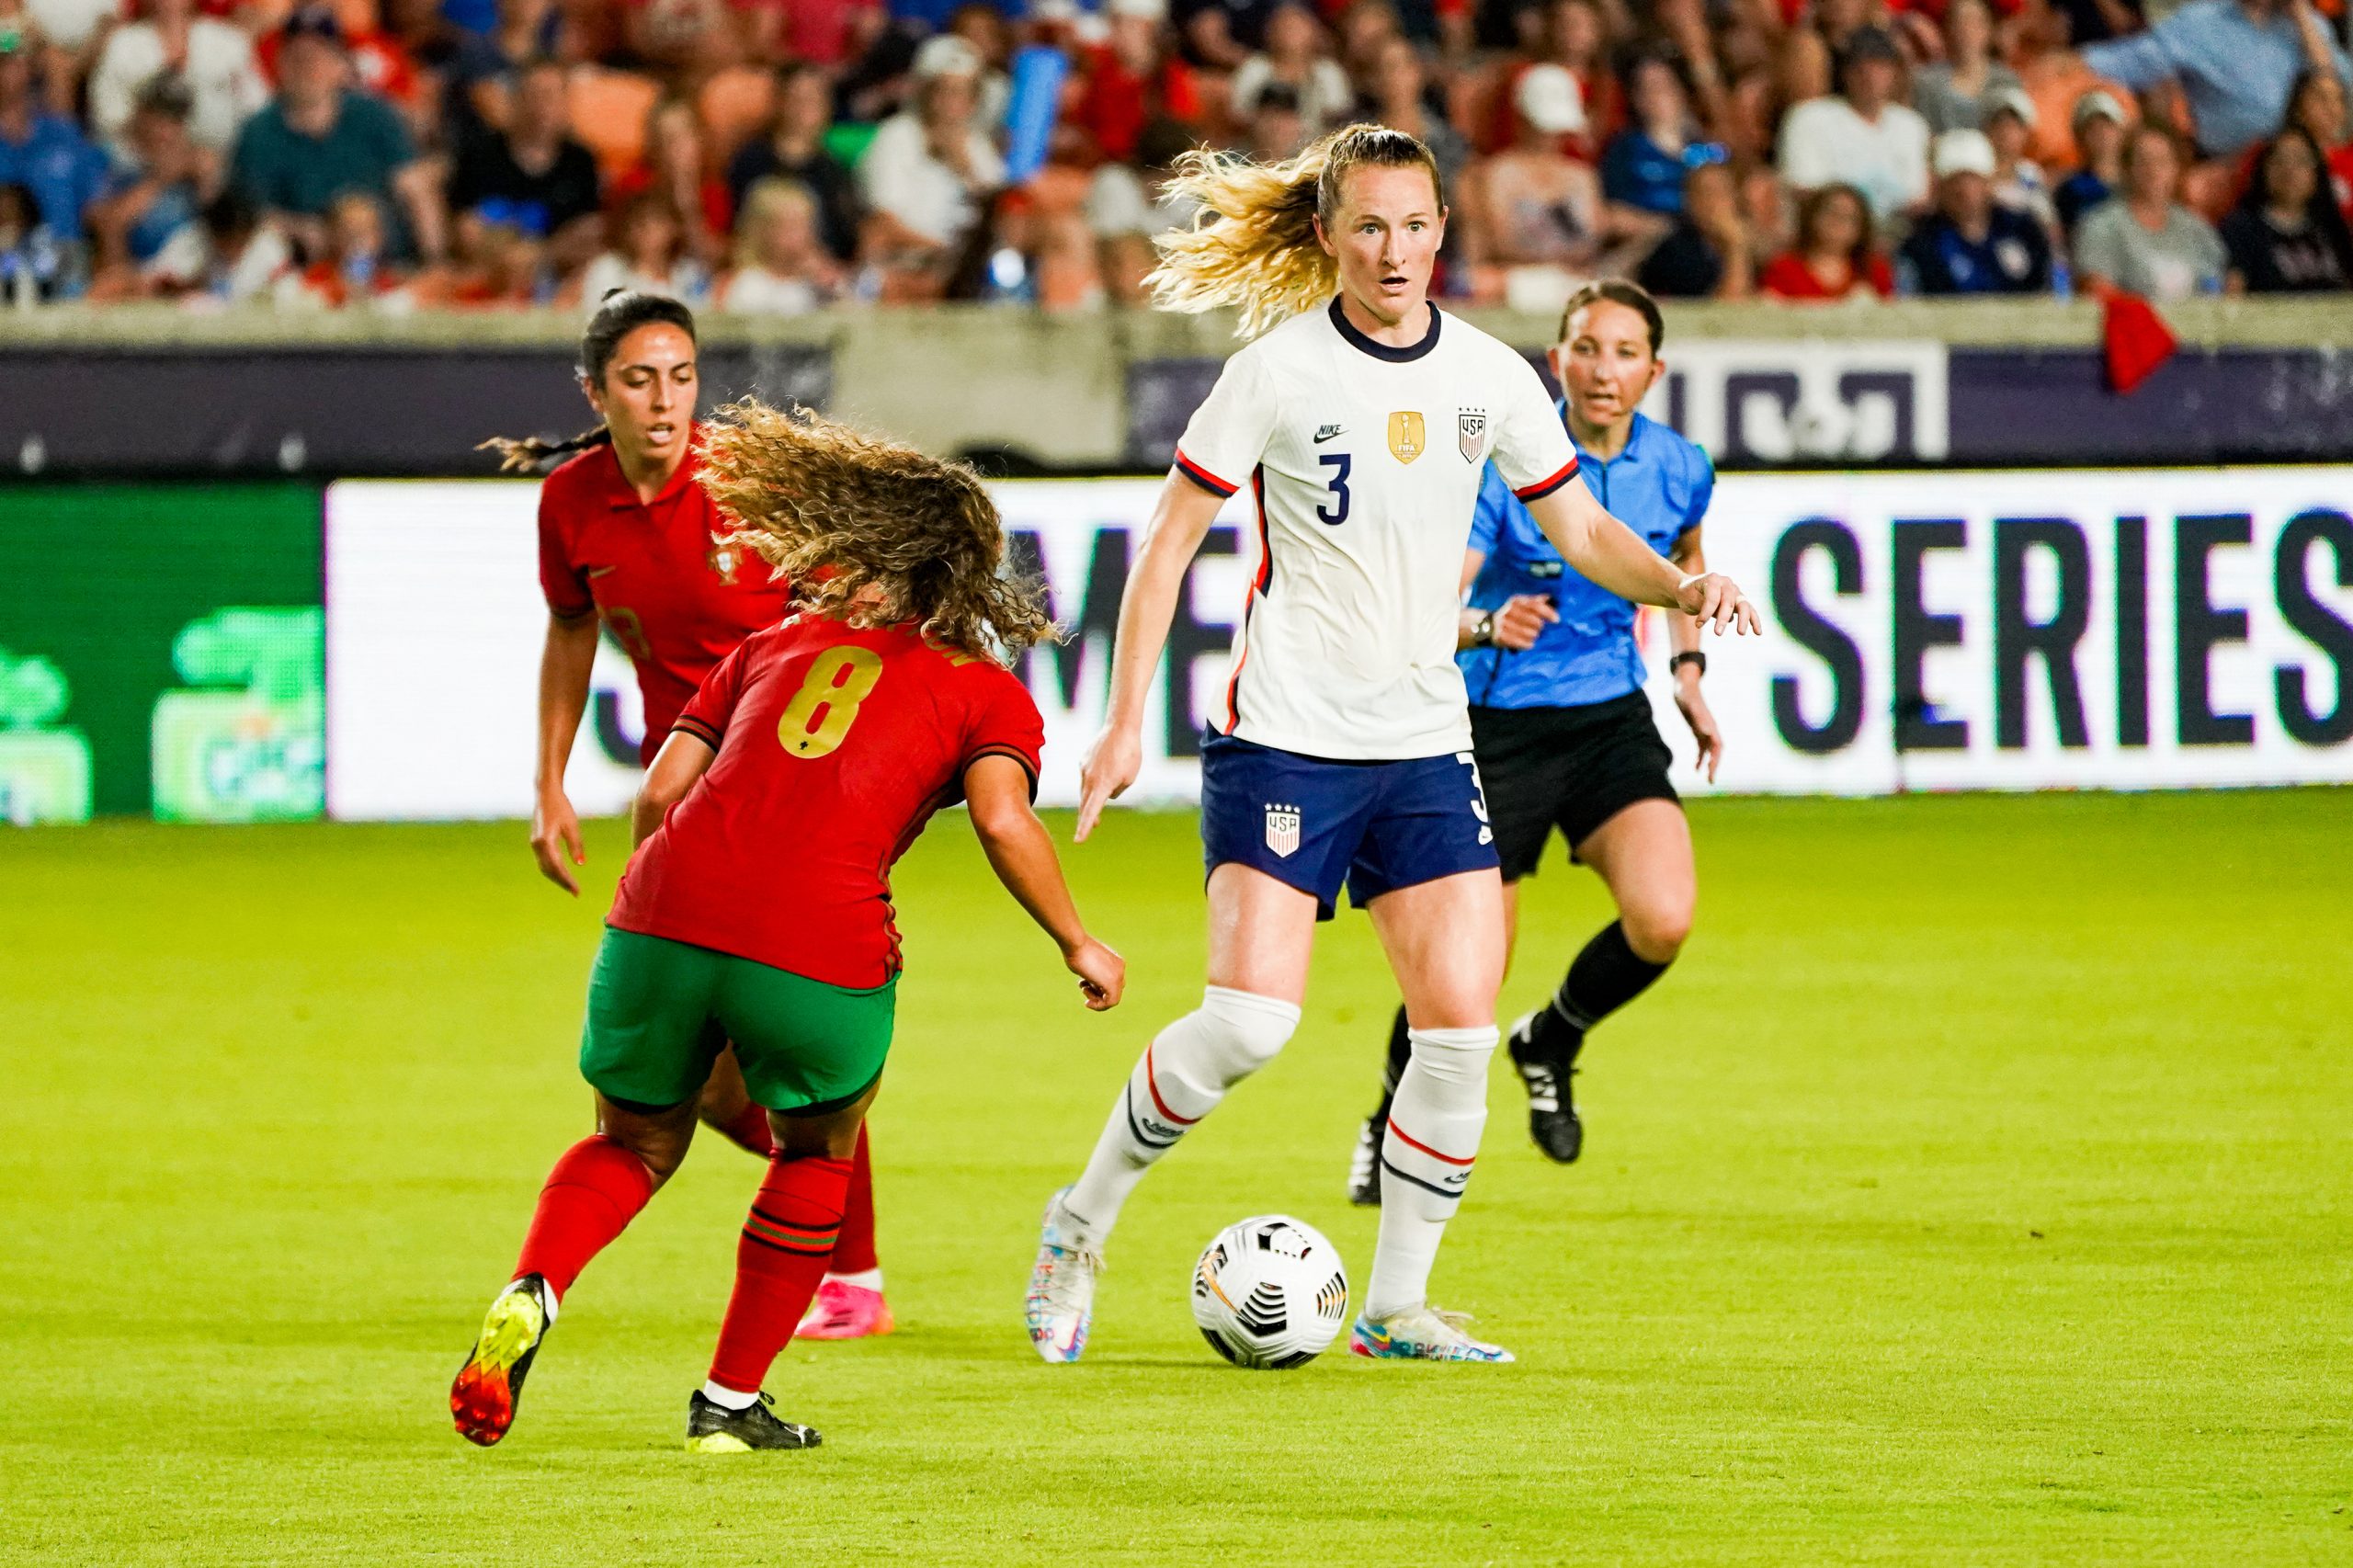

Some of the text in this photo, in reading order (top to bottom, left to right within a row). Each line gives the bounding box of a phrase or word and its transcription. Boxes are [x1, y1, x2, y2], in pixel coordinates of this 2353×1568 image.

[1318, 424, 1341, 436] NIKE
[1461, 418, 1483, 436] USA
[1397, 443, 1415, 452] FIFA
[1316, 453, 1351, 526] 3
[1770, 508, 2353, 756] SERIES
[777, 645, 883, 759] 8
[1269, 815, 1297, 832] USA
